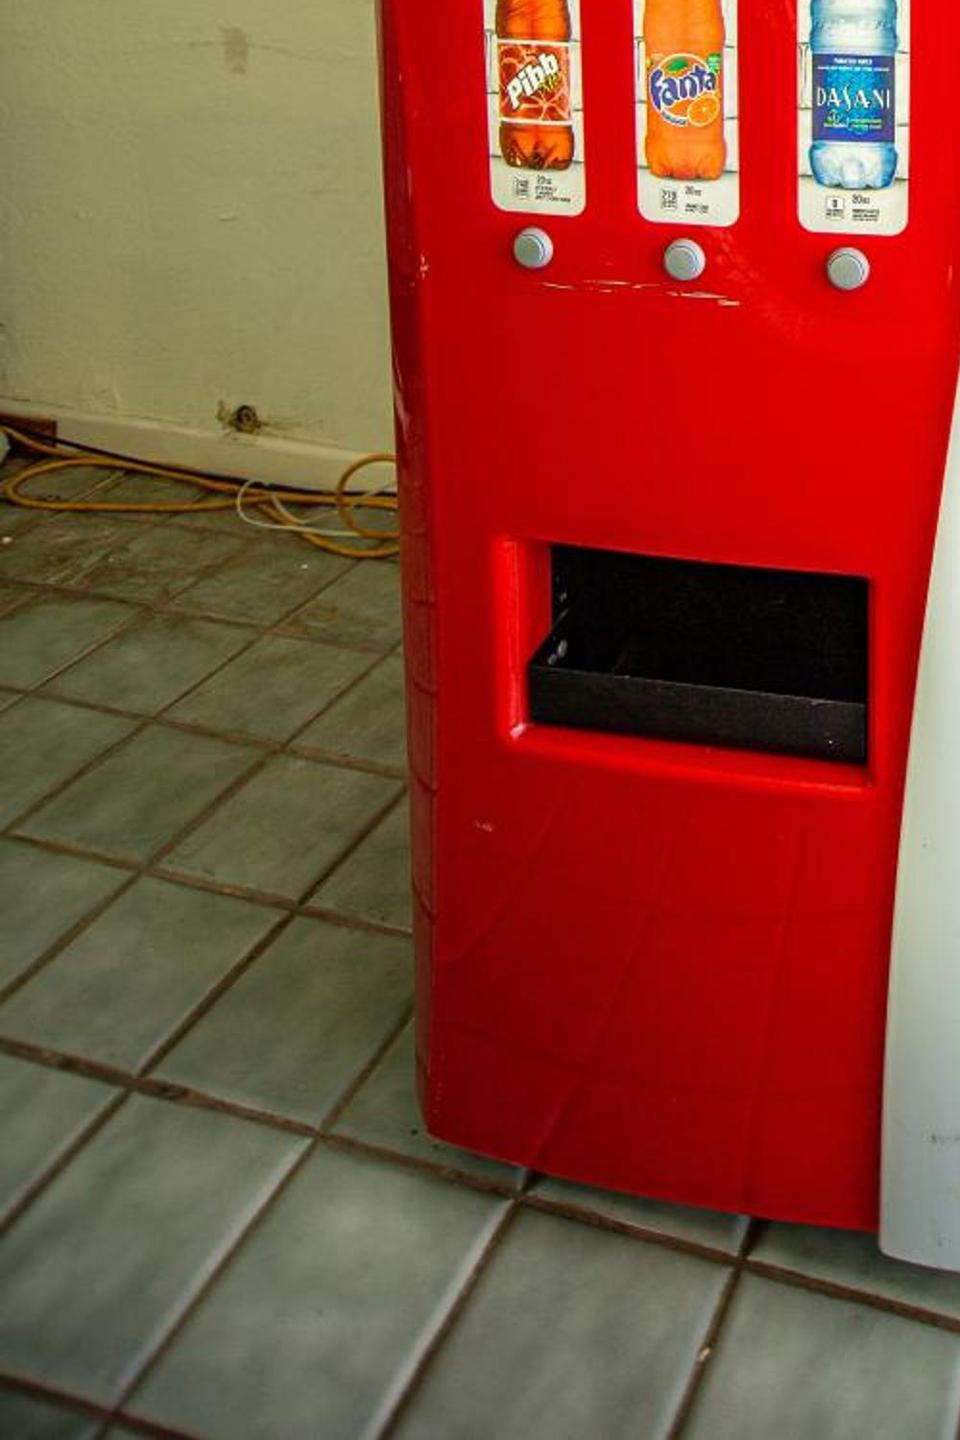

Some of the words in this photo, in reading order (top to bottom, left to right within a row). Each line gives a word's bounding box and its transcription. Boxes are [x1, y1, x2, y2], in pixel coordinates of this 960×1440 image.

[507, 53, 559, 110] Pibb
[650, 65, 716, 110] Fanta
[817, 85, 890, 111] DASANI
